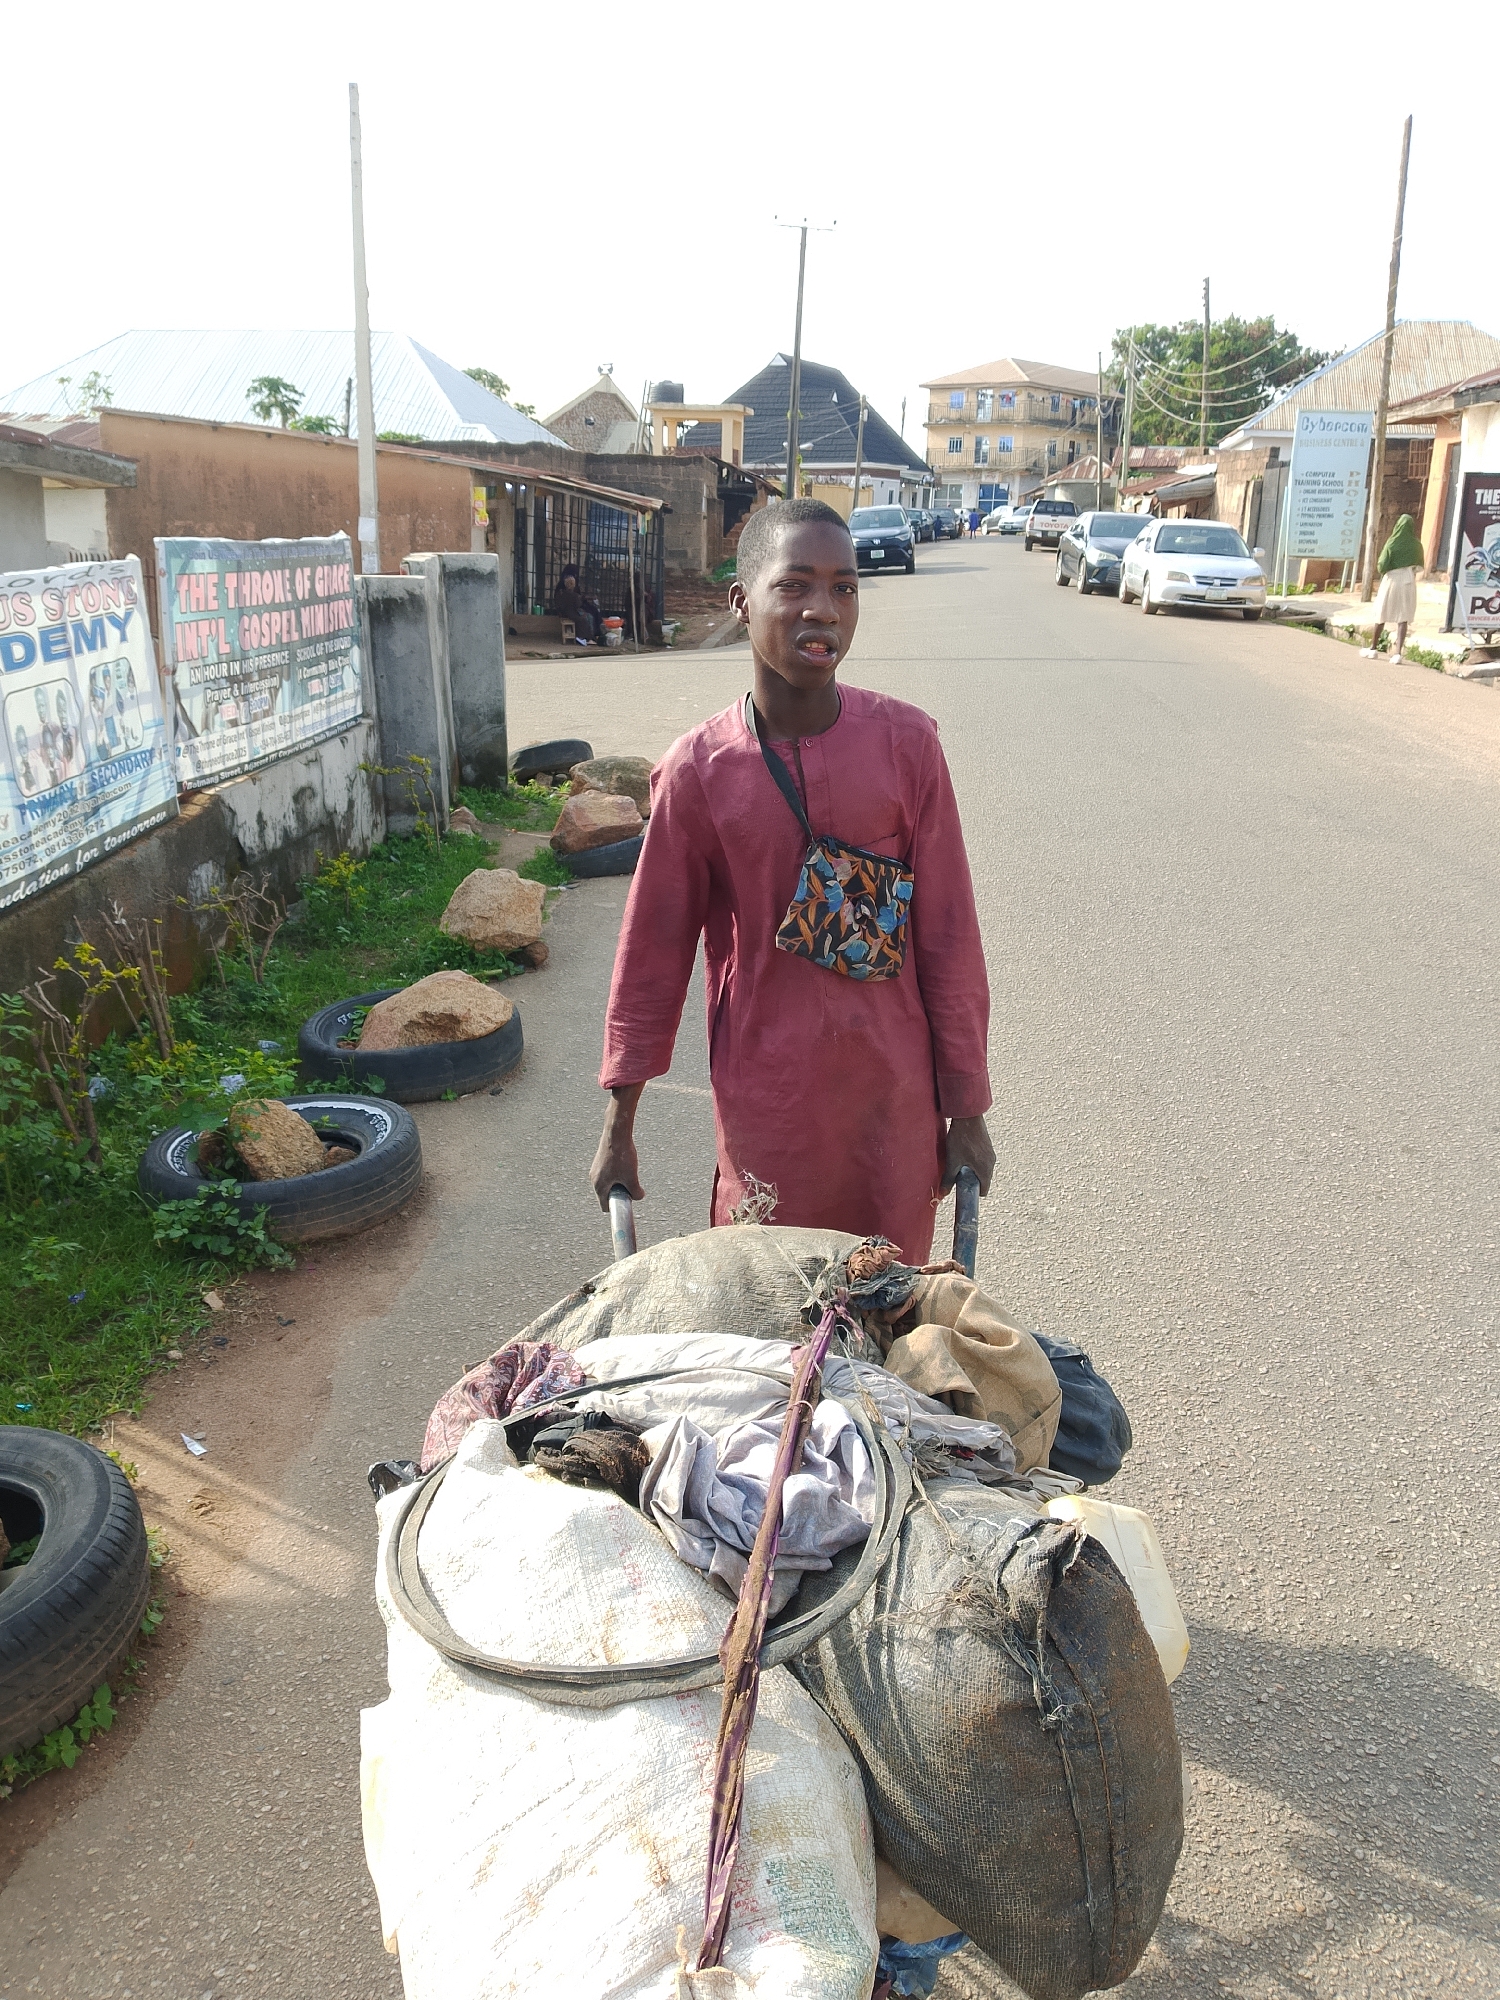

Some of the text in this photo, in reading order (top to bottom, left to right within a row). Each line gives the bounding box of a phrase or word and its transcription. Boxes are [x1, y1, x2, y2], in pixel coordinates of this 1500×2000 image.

[1301, 416, 1368, 433] Cybercom
[1333, 438, 1357, 448] CENTRE
[1294, 479, 1344, 487] TRAINING SCHOOL
[1475, 488, 1500, 505] THE
[0, 564, 126, 589] ord's
[175, 573, 219, 613] THE
[225, 569, 292, 609] THRONE
[295, 567, 311, 601] OF
[315, 563, 351, 598] GRACE
[42, 575, 138, 622] STONE
[0, 608, 135, 676] DEMY
[175, 599, 354, 662] INT'L GOSPEL MINISTRY
[296, 645, 316, 662] SCHOOL
[316, 642, 324, 655] OF
[190, 651, 290, 686] AN HOUR IN HIS PRESENCE
[205, 687, 231, 708] (Prayer
[233, 684, 240, 697] &
[75, 848, 99, 873] for
[104, 811, 167, 852] tomorrow
